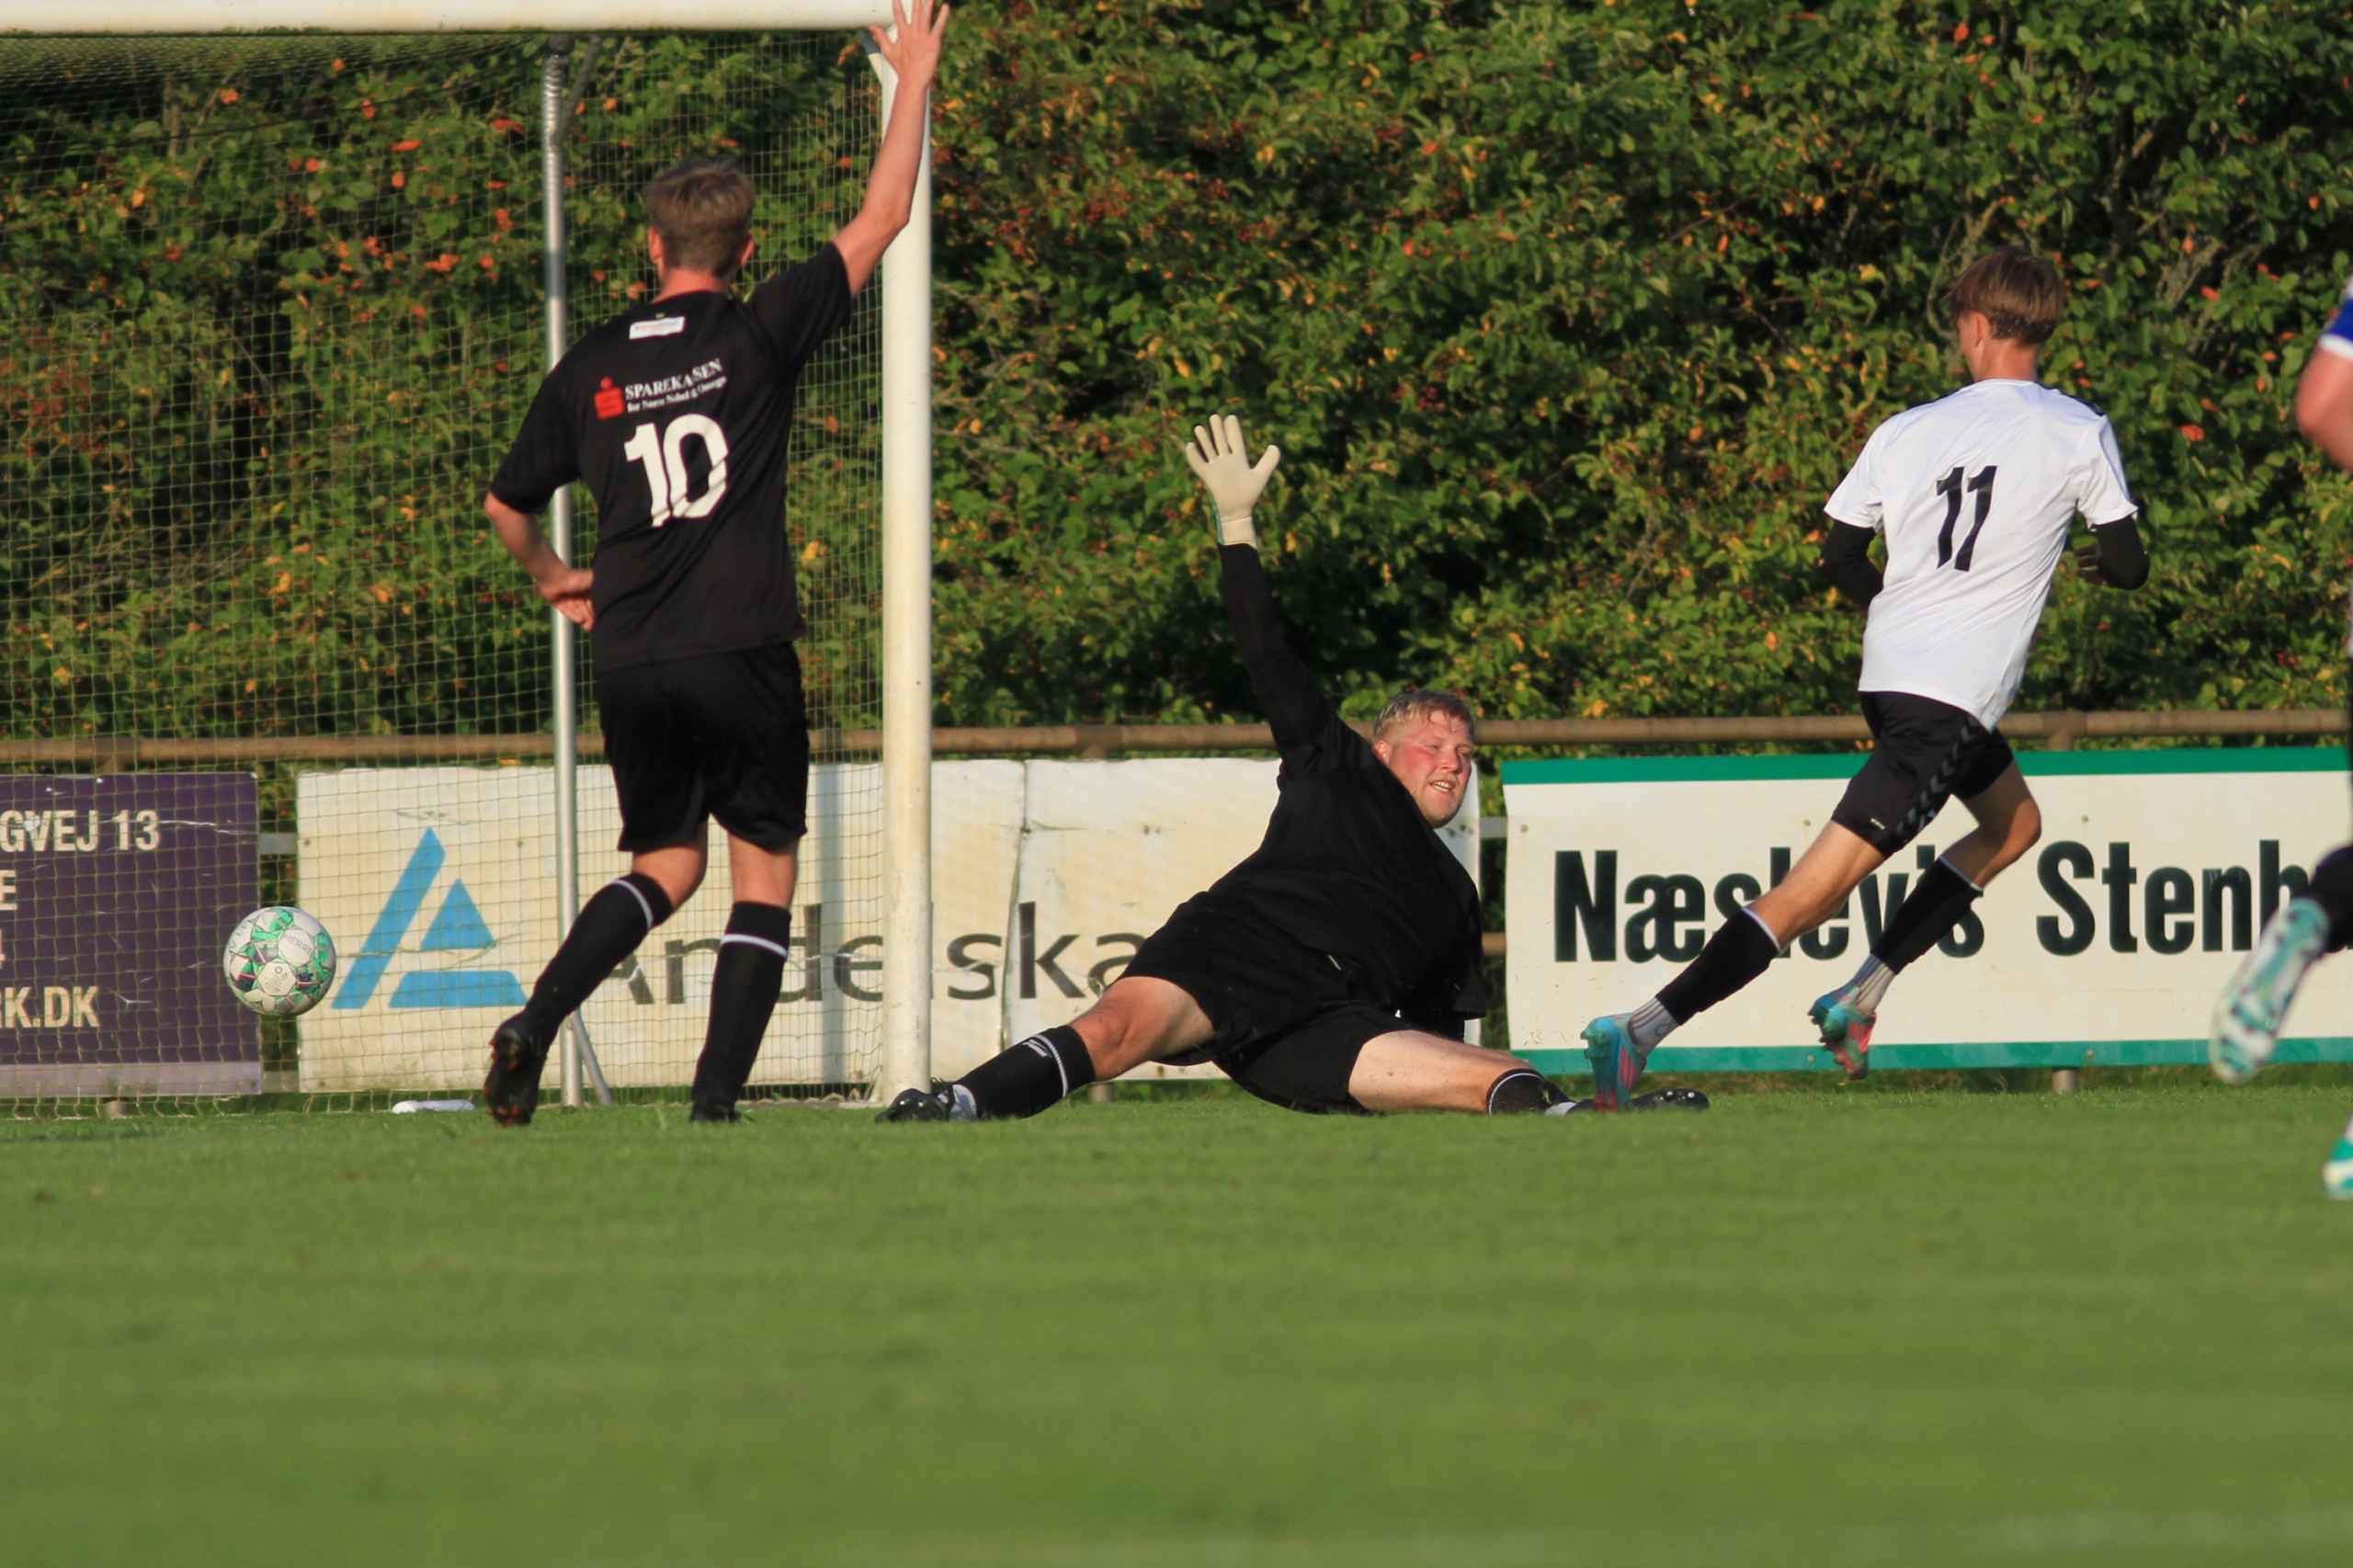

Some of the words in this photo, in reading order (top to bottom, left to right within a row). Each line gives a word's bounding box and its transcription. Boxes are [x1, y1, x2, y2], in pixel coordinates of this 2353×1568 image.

[624, 414, 728, 528] 10
[1935, 465, 1997, 572] 11
[112, 809, 160, 851] 13
[0, 986, 100, 1028] K.DK
